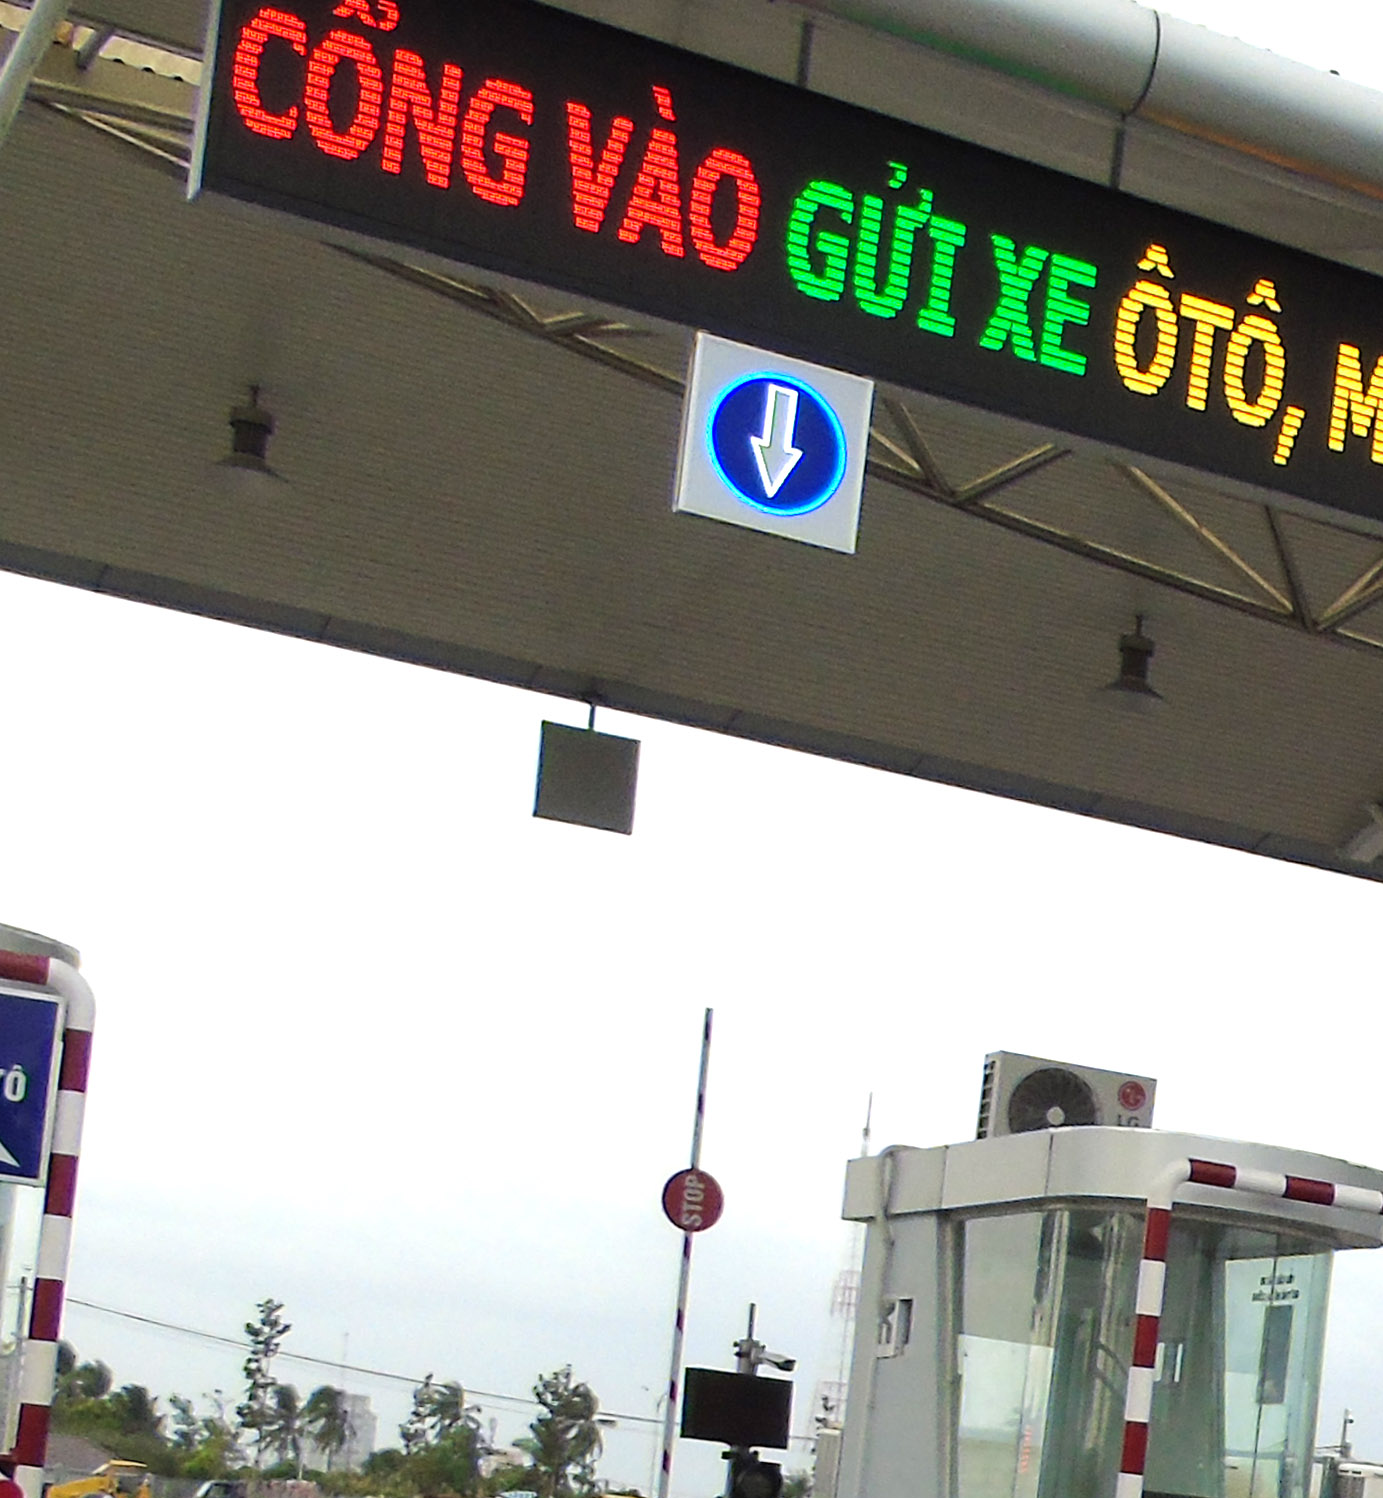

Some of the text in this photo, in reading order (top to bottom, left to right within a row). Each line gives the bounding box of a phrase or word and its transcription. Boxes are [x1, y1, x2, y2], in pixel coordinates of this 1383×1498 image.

[566, 85, 761, 272] VÀO
[785, 161, 966, 338] GỬI
[979, 234, 1098, 376] XE
[1113, 243, 1306, 466] ÔTÔ,
[683, 1174, 705, 1227] STOP
